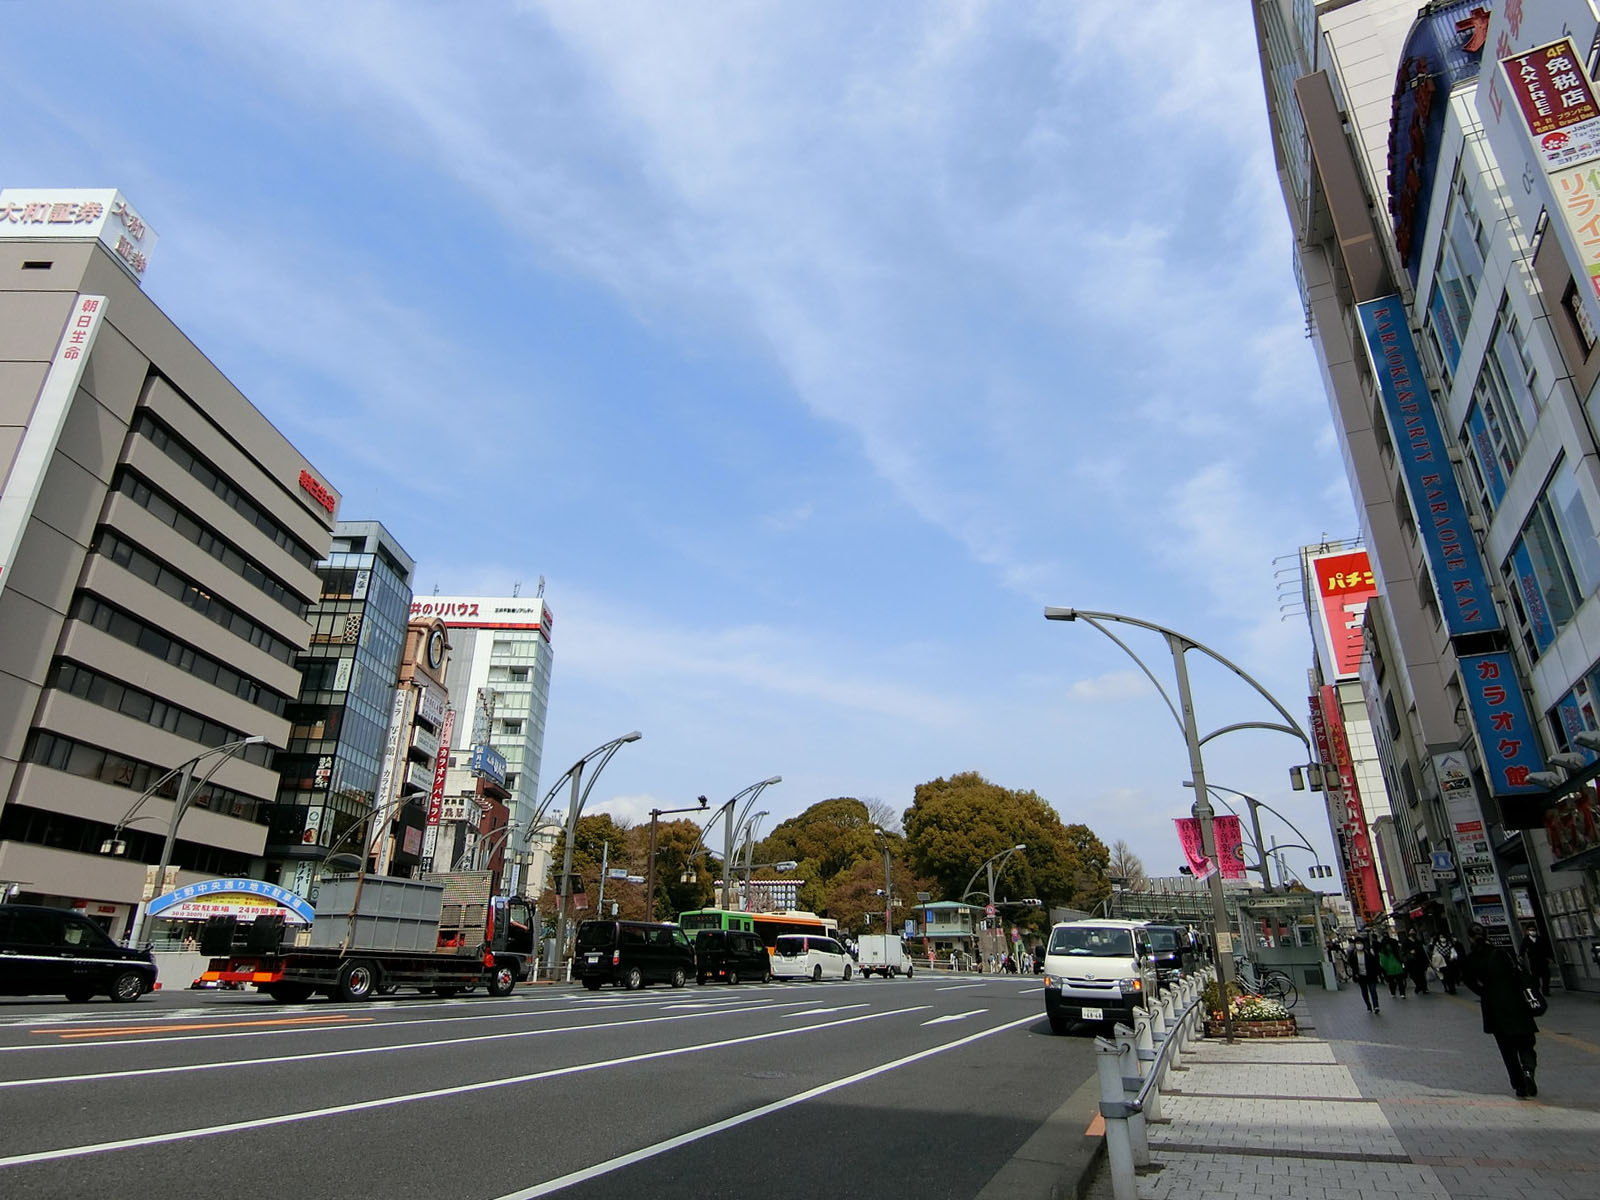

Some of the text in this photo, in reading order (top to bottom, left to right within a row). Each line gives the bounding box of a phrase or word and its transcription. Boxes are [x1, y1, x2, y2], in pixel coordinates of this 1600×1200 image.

[1546, 44, 1567, 58] 4F
[1515, 56, 1552, 117] TAX FREE
[1545, 57, 1586, 108] 免税店
[0, 202, 104, 224] 大和証券
[64, 299, 99, 360] 朝日生命
[1421, 473, 1467, 572] KARAOKE
[1451, 578, 1482, 624] KAN
[1476, 660, 1533, 788] カラオケ館
[379, 769, 391, 802] カラオケ
[431, 749, 448, 816] カラオケ パセラ
[173, 880, 303, 909] 上野中央通り地下駐車場
[181, 903, 230, 912] 区営駐車場
[238, 906, 286, 916] 24時間営業
